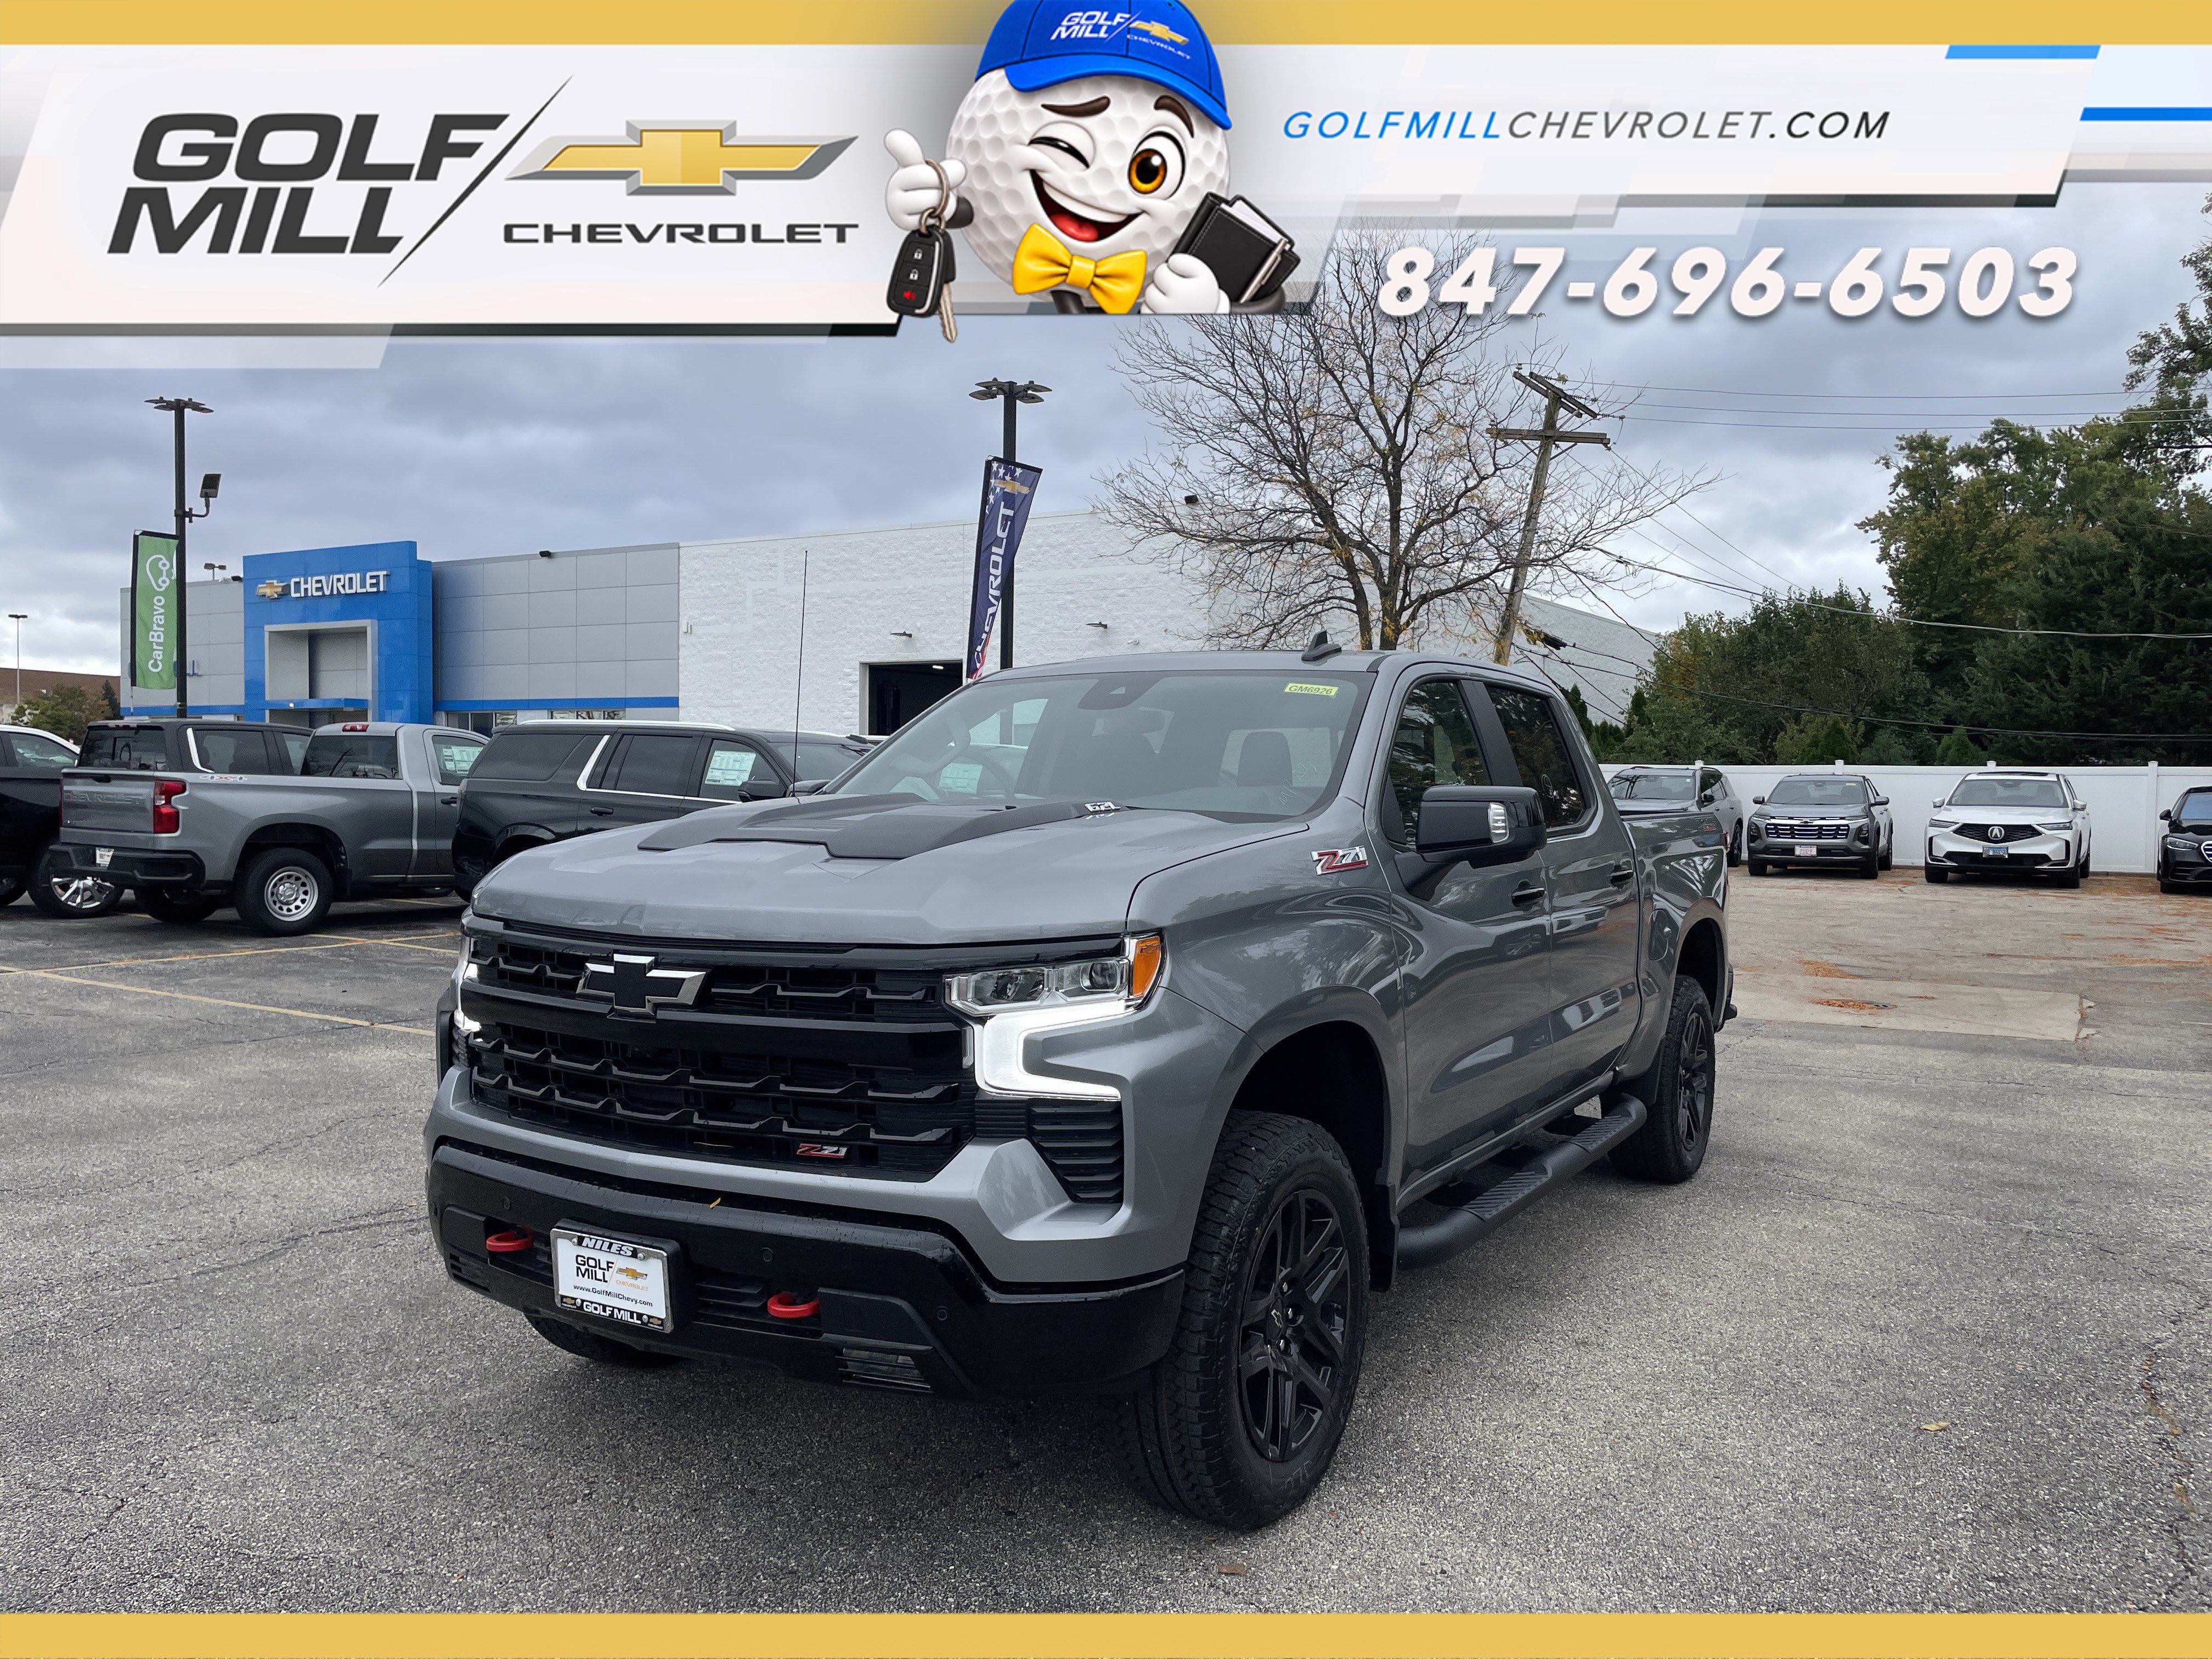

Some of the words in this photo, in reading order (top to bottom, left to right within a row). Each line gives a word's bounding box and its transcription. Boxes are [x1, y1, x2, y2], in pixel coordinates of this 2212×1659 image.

[290, 570, 387, 598] CHEVROLET
[148, 596, 166, 673] CarBravo
[1289, 685, 1333, 695] GM6926
[1311, 845, 1369, 876] Z71
[796, 1143, 849, 1159] Z71
[582, 1237, 634, 1257] NILES
[575, 1254, 615, 1272] GOLF
[575, 1266, 608, 1283] MILL
[616, 1279, 649, 1291] CHEVROLET
[573, 1284, 653, 1307] www.GolfMillChevy.com
[583, 1301, 613, 1317] GOLF
[613, 1310, 641, 1324] MILL
